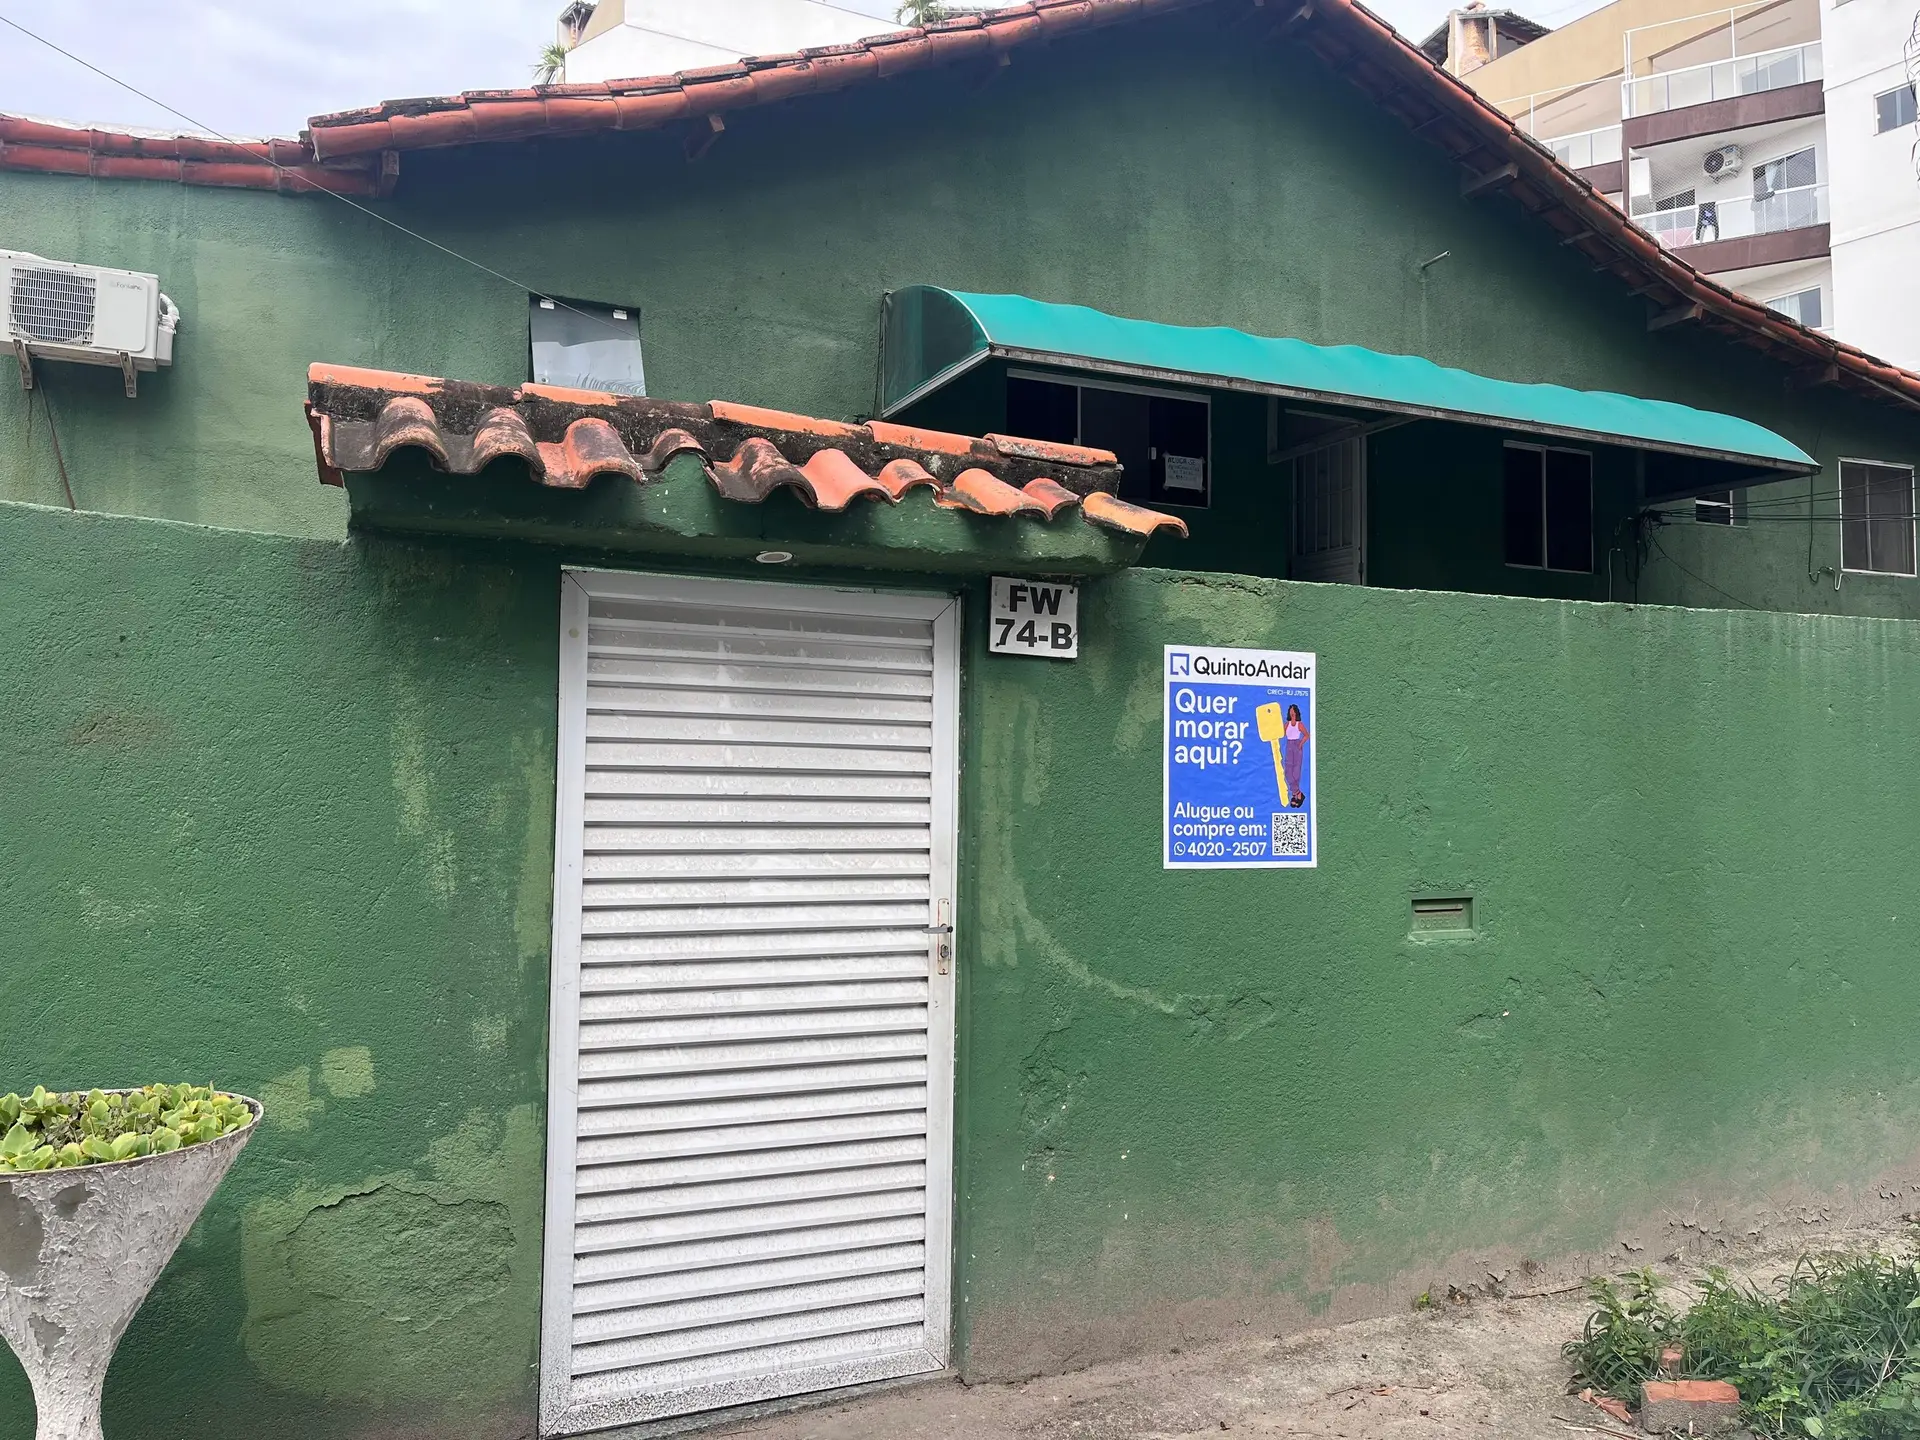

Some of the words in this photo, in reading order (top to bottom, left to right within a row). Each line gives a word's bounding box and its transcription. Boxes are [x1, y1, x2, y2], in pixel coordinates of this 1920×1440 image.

[1009, 584, 1063, 616] FW
[995, 618, 1073, 650] 74-B
[1193, 656, 1311, 680] QuintoAndar
[1175, 688, 1238, 713] Quer
[1175, 719, 1249, 739] morar
[1174, 740, 1243, 770] aqui?
[1173, 802, 1231, 822] Alugue
[1234, 805, 1254, 818] ou
[1173, 823, 1235, 839] compre
[1238, 823, 1267, 837] em:
